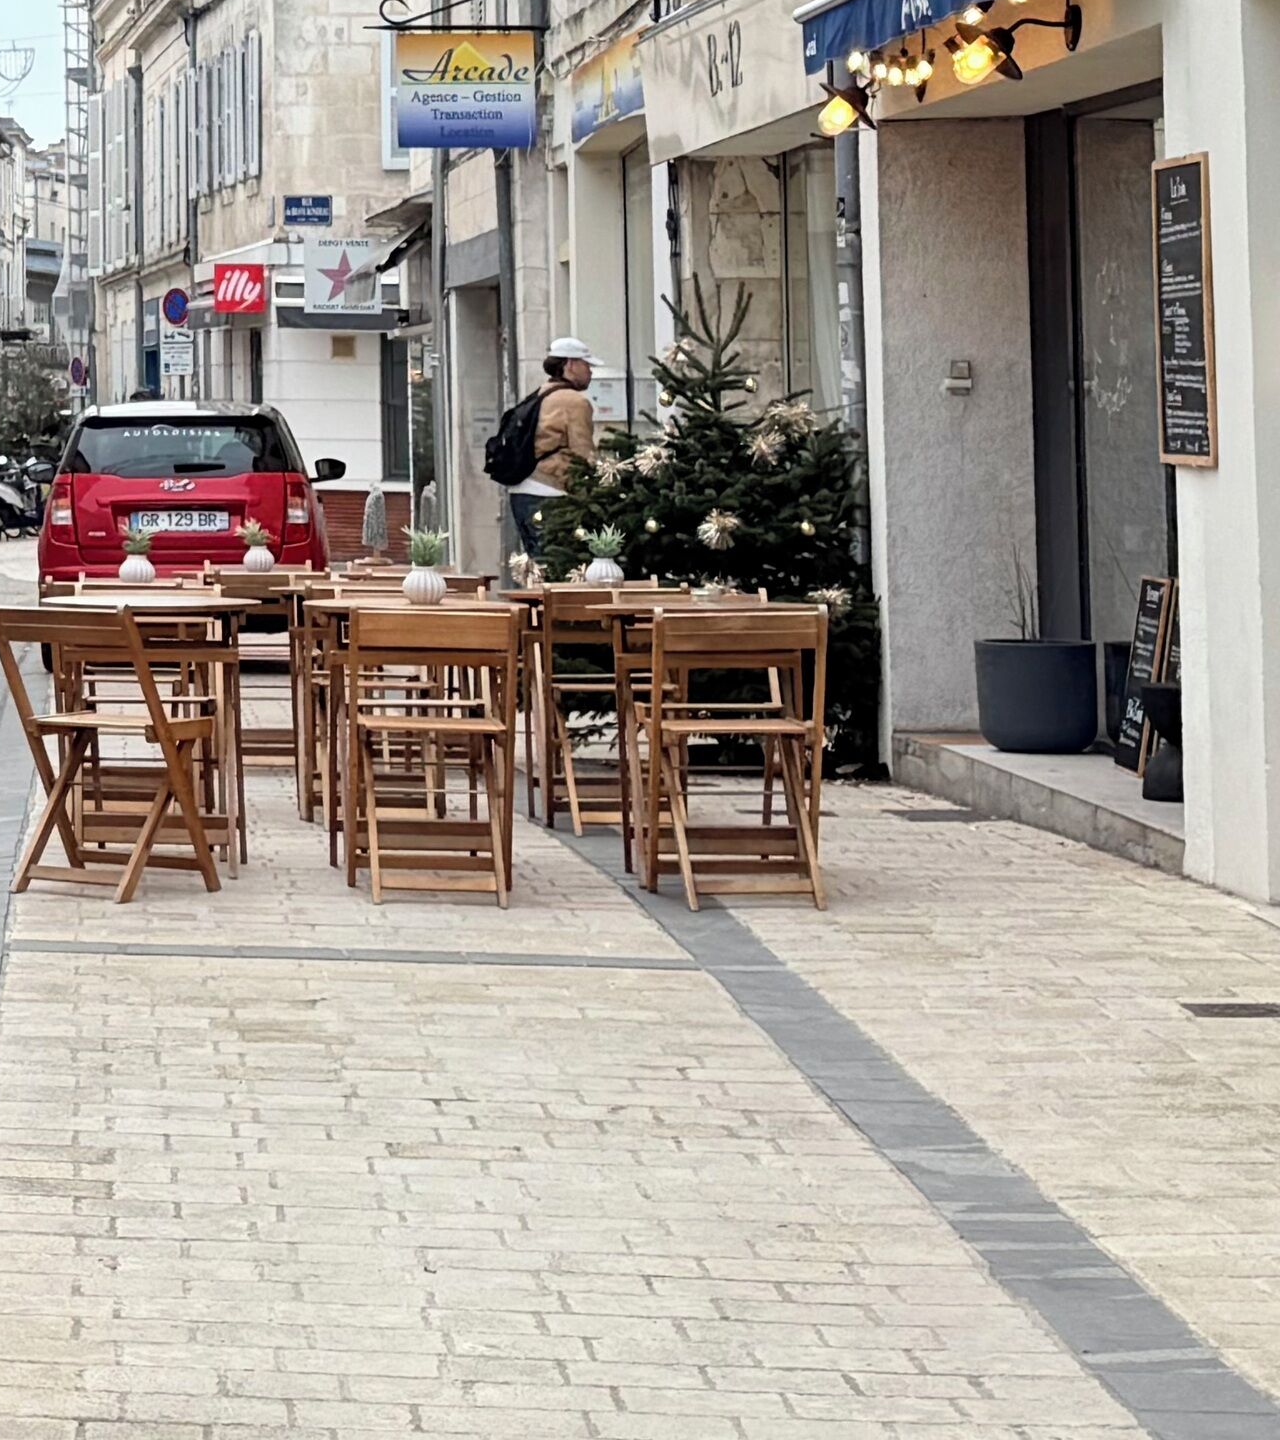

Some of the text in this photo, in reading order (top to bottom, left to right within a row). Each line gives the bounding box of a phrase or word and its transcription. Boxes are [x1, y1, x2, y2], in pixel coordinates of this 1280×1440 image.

[401, 48, 530, 82] Arcade
[411, 90, 522, 105] Agence Gestion
[430, 109, 503, 121] Transaction
[440, 126, 495, 139] Location
[217, 269, 261, 311] illy
